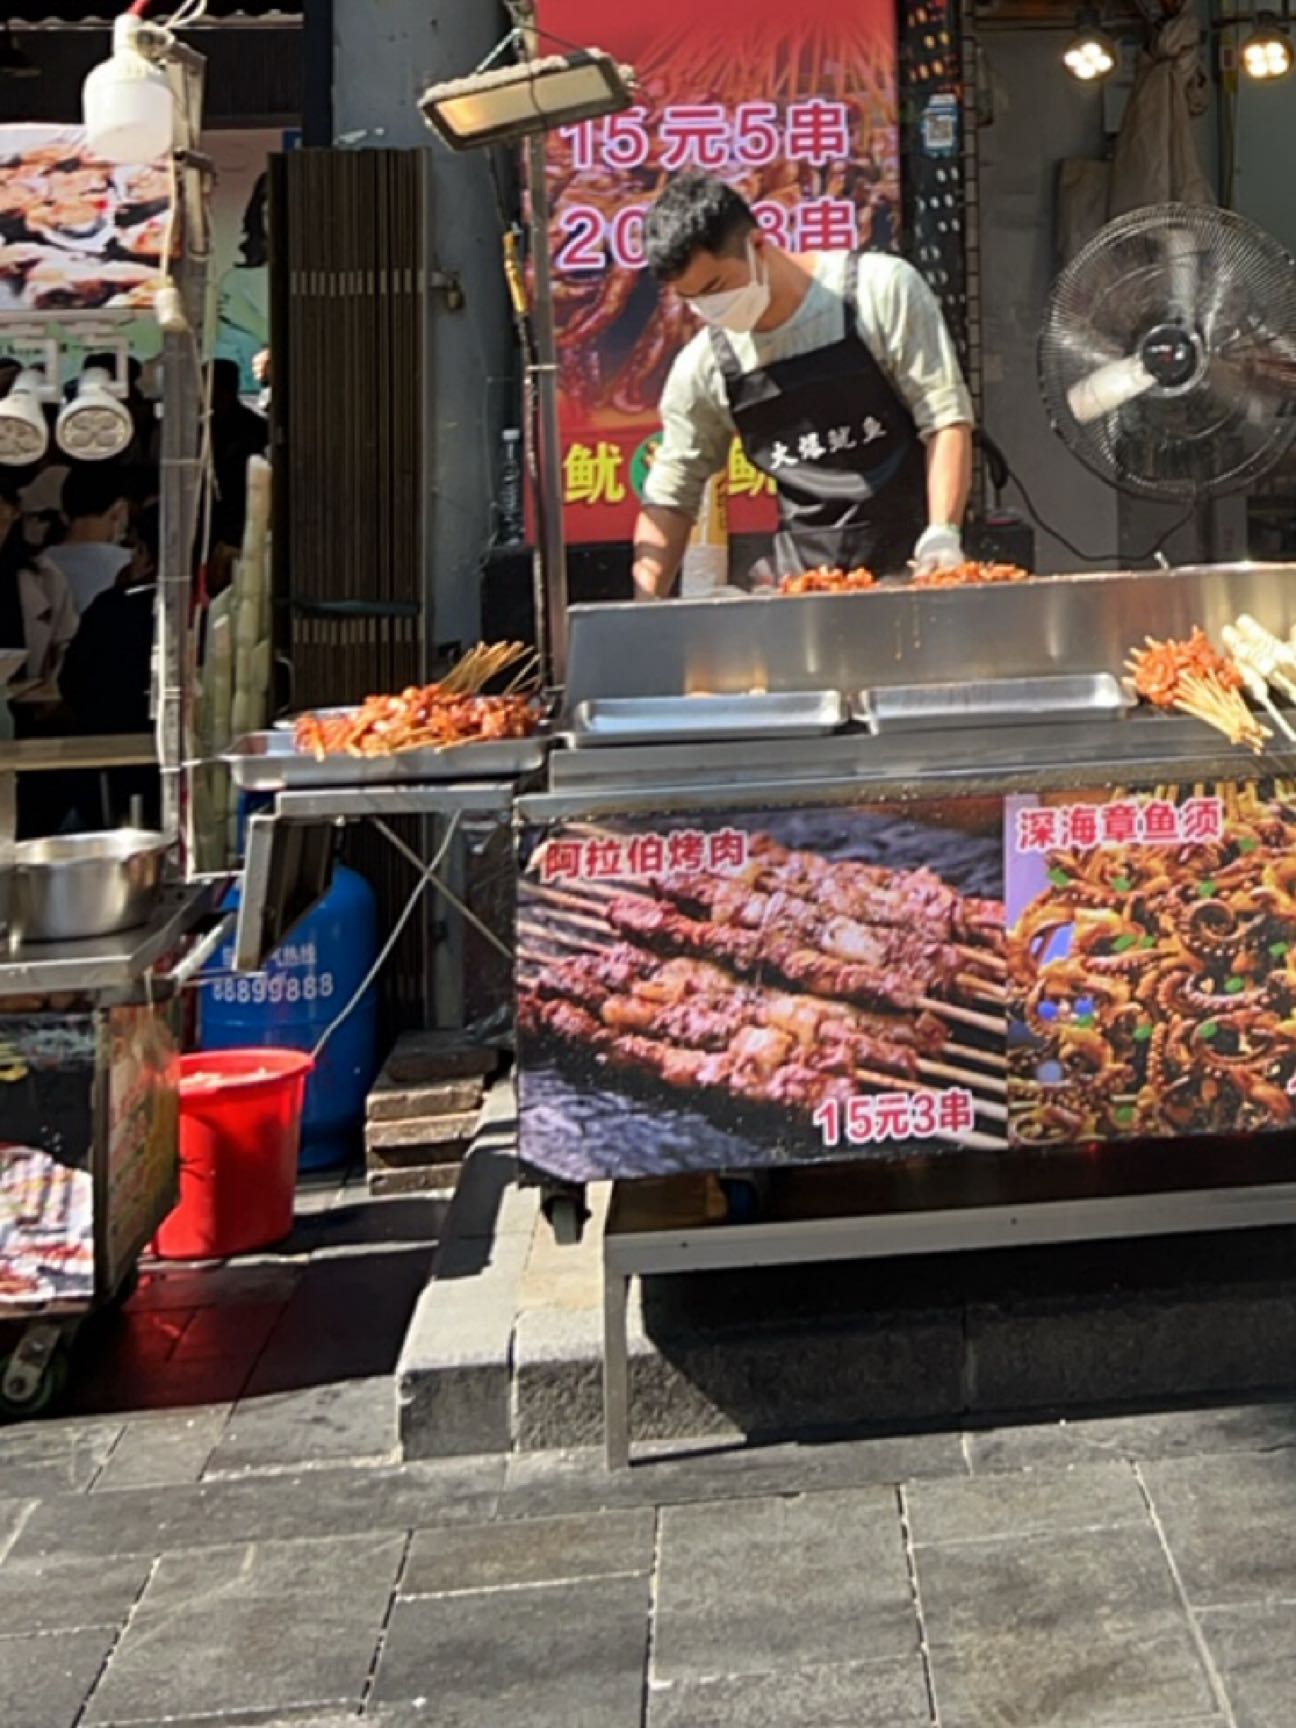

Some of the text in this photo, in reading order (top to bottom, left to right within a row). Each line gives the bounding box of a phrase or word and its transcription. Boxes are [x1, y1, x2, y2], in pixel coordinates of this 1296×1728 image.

[560, 99, 849, 170] 15元5串
[555, 195, 859, 269] 208串
[1016, 797, 1224, 853] 深海章鱼须
[541, 828, 750, 882] 阿拉伯烤肉
[813, 1088, 974, 1146] 15元3串
